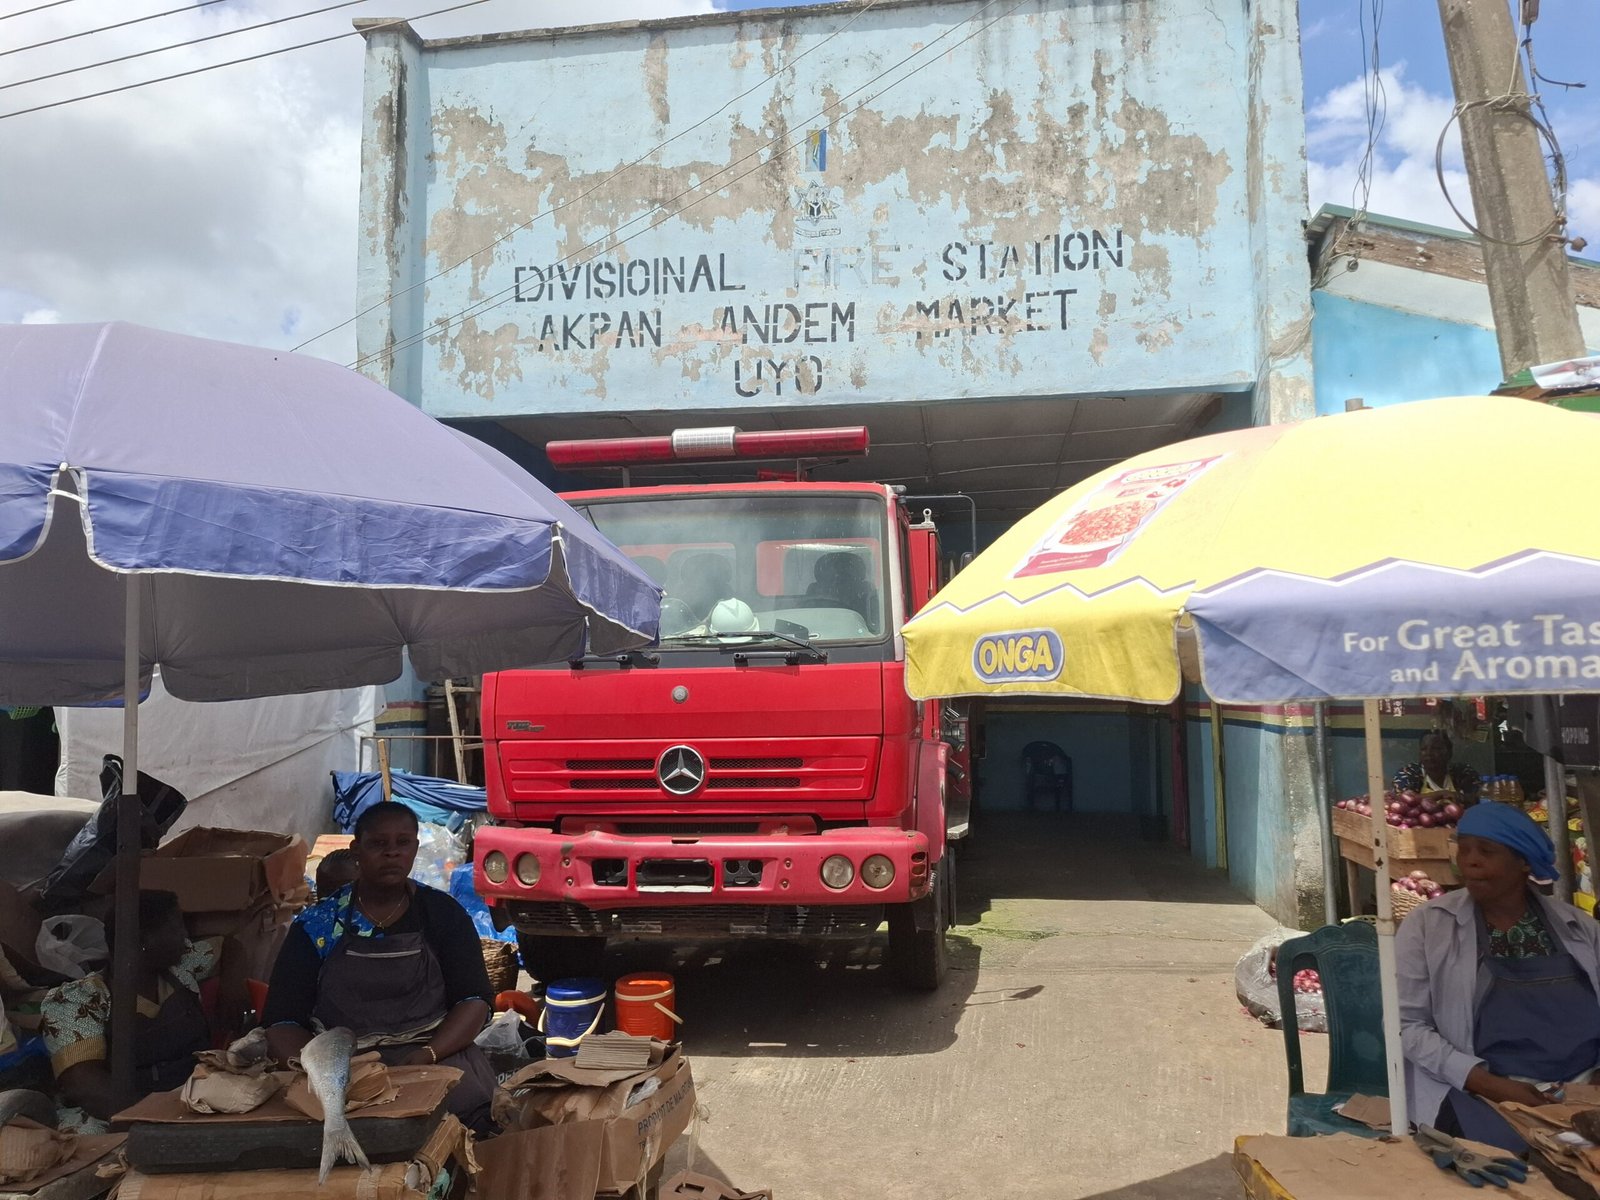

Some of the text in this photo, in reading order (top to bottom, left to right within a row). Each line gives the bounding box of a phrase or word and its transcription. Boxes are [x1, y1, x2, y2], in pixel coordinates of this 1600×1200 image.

[537, 288, 1078, 352] AKPAN ANDEM MARKET
[734, 355, 823, 398] UYO
[977, 633, 1054, 676] ONGA
[1343, 631, 1390, 653] For
[1397, 618, 1521, 651] Great
[1390, 661, 1440, 683] and
